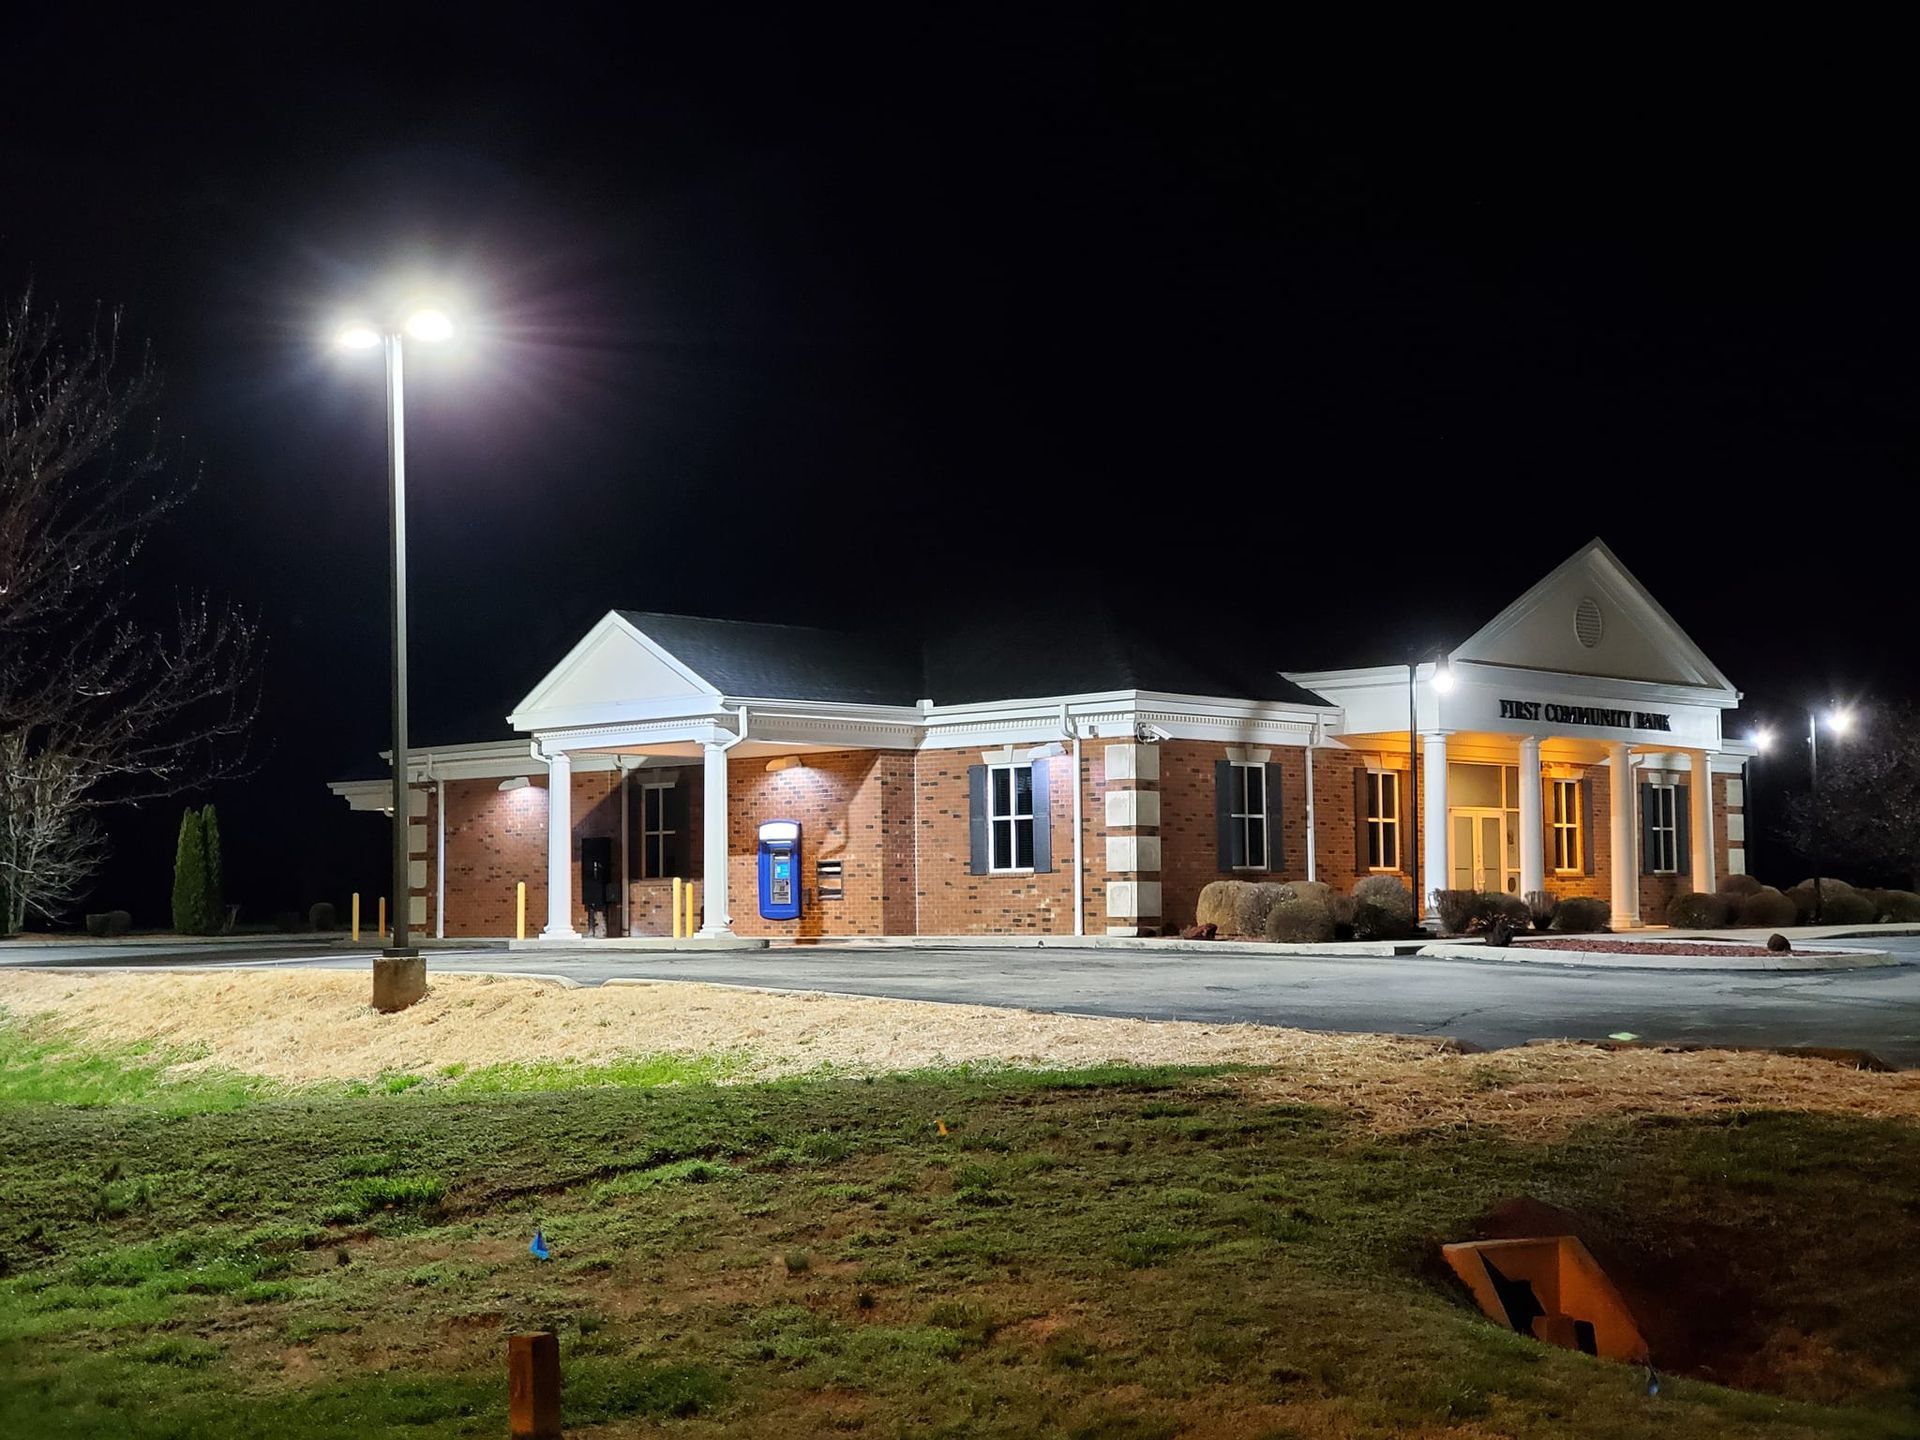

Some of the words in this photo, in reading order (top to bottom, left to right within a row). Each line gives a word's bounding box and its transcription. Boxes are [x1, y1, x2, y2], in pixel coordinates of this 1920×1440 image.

[1499, 699, 1541, 720] FIRST
[1545, 703, 1632, 728] COMMUNITY
[1634, 711, 1671, 731] BANK
